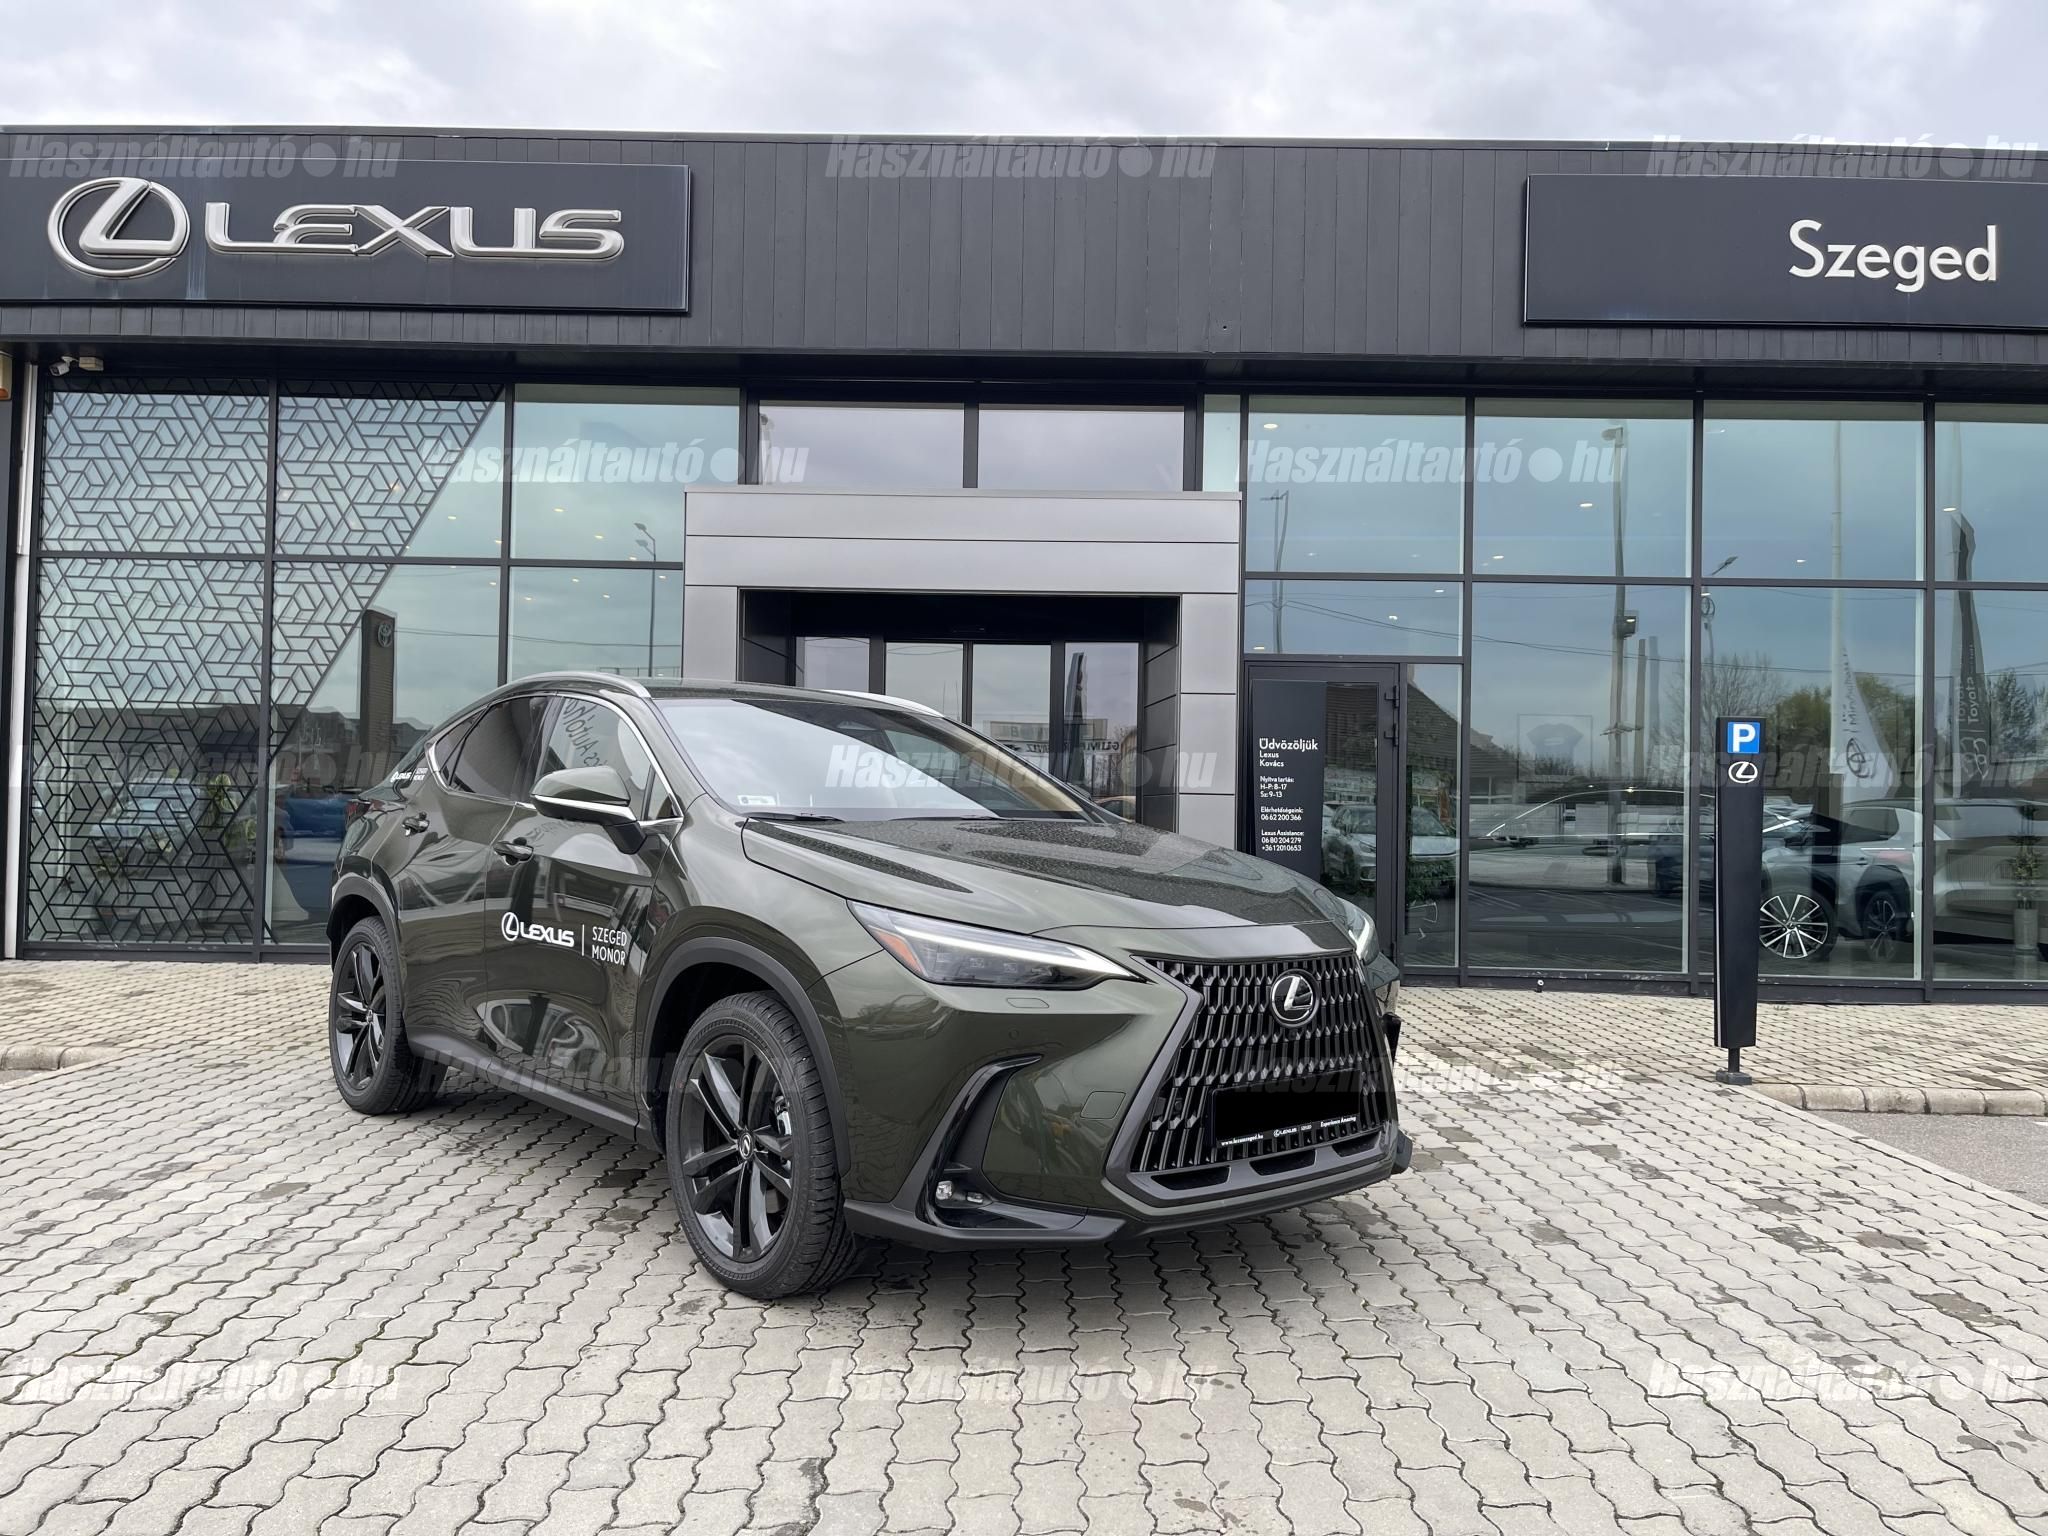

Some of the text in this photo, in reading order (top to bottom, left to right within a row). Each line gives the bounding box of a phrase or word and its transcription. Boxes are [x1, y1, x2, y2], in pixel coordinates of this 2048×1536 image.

[205, 202, 625, 261] LEXUS
[1788, 219, 1998, 293] Szeged
[1259, 738, 1319, 752] Üdvözöljük
[1732, 724, 1756, 752] P
[1259, 750, 1280, 758] Lexus
[1259, 759, 1285, 767] Kovács
[520, 921, 575, 948] LEXUS
[592, 926, 628, 948] SZEGED
[591, 944, 626, 966] MONOR
